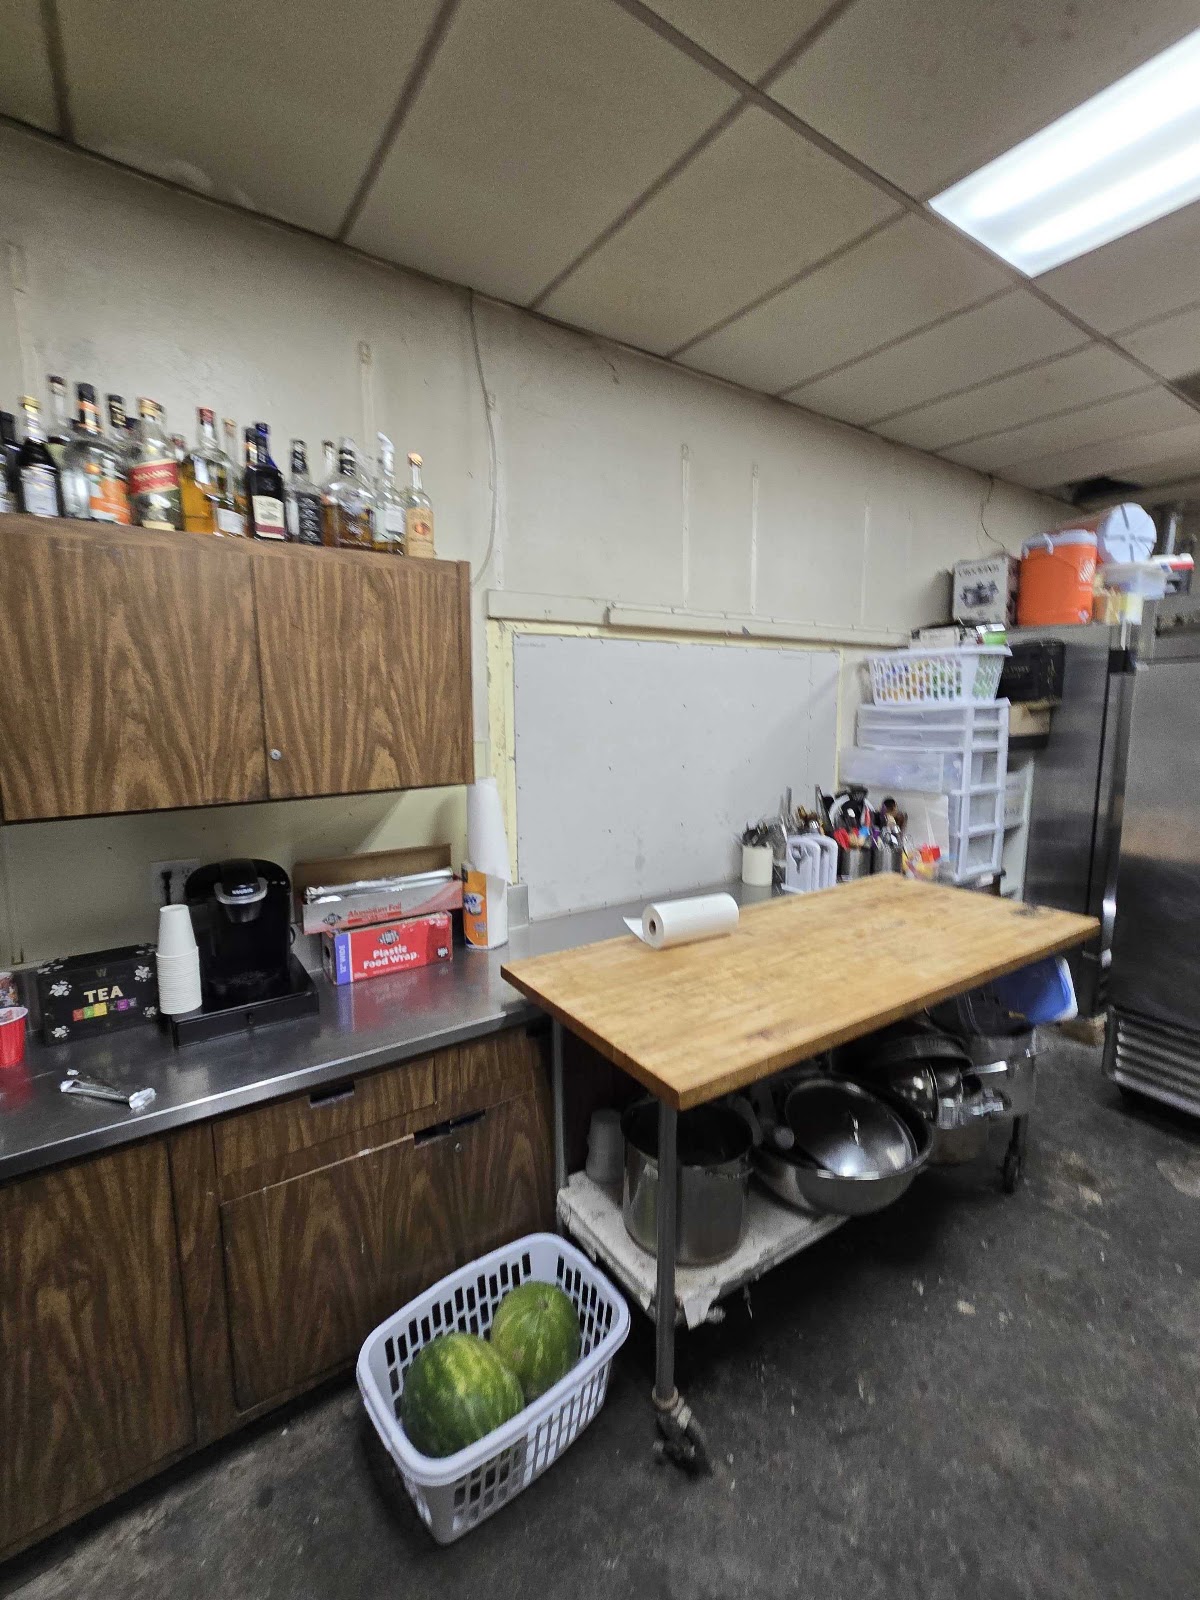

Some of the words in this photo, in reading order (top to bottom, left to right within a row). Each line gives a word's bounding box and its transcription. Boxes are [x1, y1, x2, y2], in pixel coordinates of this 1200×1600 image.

[373, 944, 407, 959] Plastic
[363, 957, 389, 969] Food
[83, 985, 124, 1003] TEA
